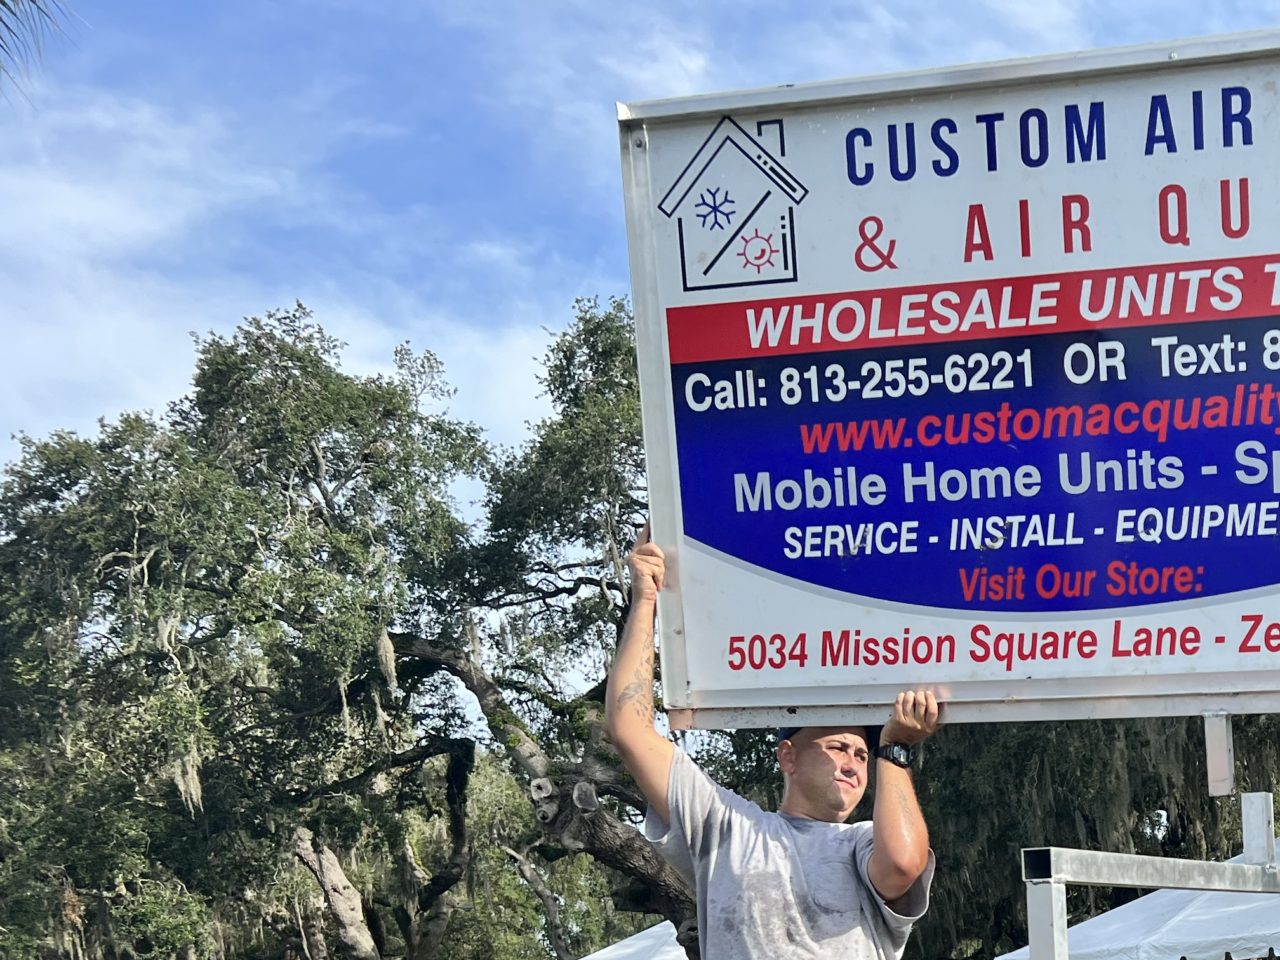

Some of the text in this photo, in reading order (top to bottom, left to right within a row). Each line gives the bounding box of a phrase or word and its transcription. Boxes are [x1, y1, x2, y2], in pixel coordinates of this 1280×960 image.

[844, 100, 1106, 187] CUSTOM
[1144, 86, 1253, 157] AIR
[854, 215, 898, 272] &
[963, 193, 1092, 265] AIR
[745, 281, 1060, 349] WHOLESALE
[1078, 264, 1244, 323] UNITS
[685, 371, 767, 412] Call:
[779, 347, 1033, 407] 813-255-6221
[1063, 341, 1127, 385] OR
[1151, 334, 1247, 379] Text:
[734, 465, 886, 512] Mobile
[903, 460, 1041, 504] Home
[1058, 447, 1184, 495] Units
[783, 520, 918, 559] SERVICE
[949, 513, 1084, 551] INSTALL
[958, 559, 1204, 602] Visit Our Store:
[727, 632, 808, 671] 5034
[820, 627, 955, 667] Mission
[969, 624, 1097, 671] Square
[1111, 619, 1201, 658] Lane
